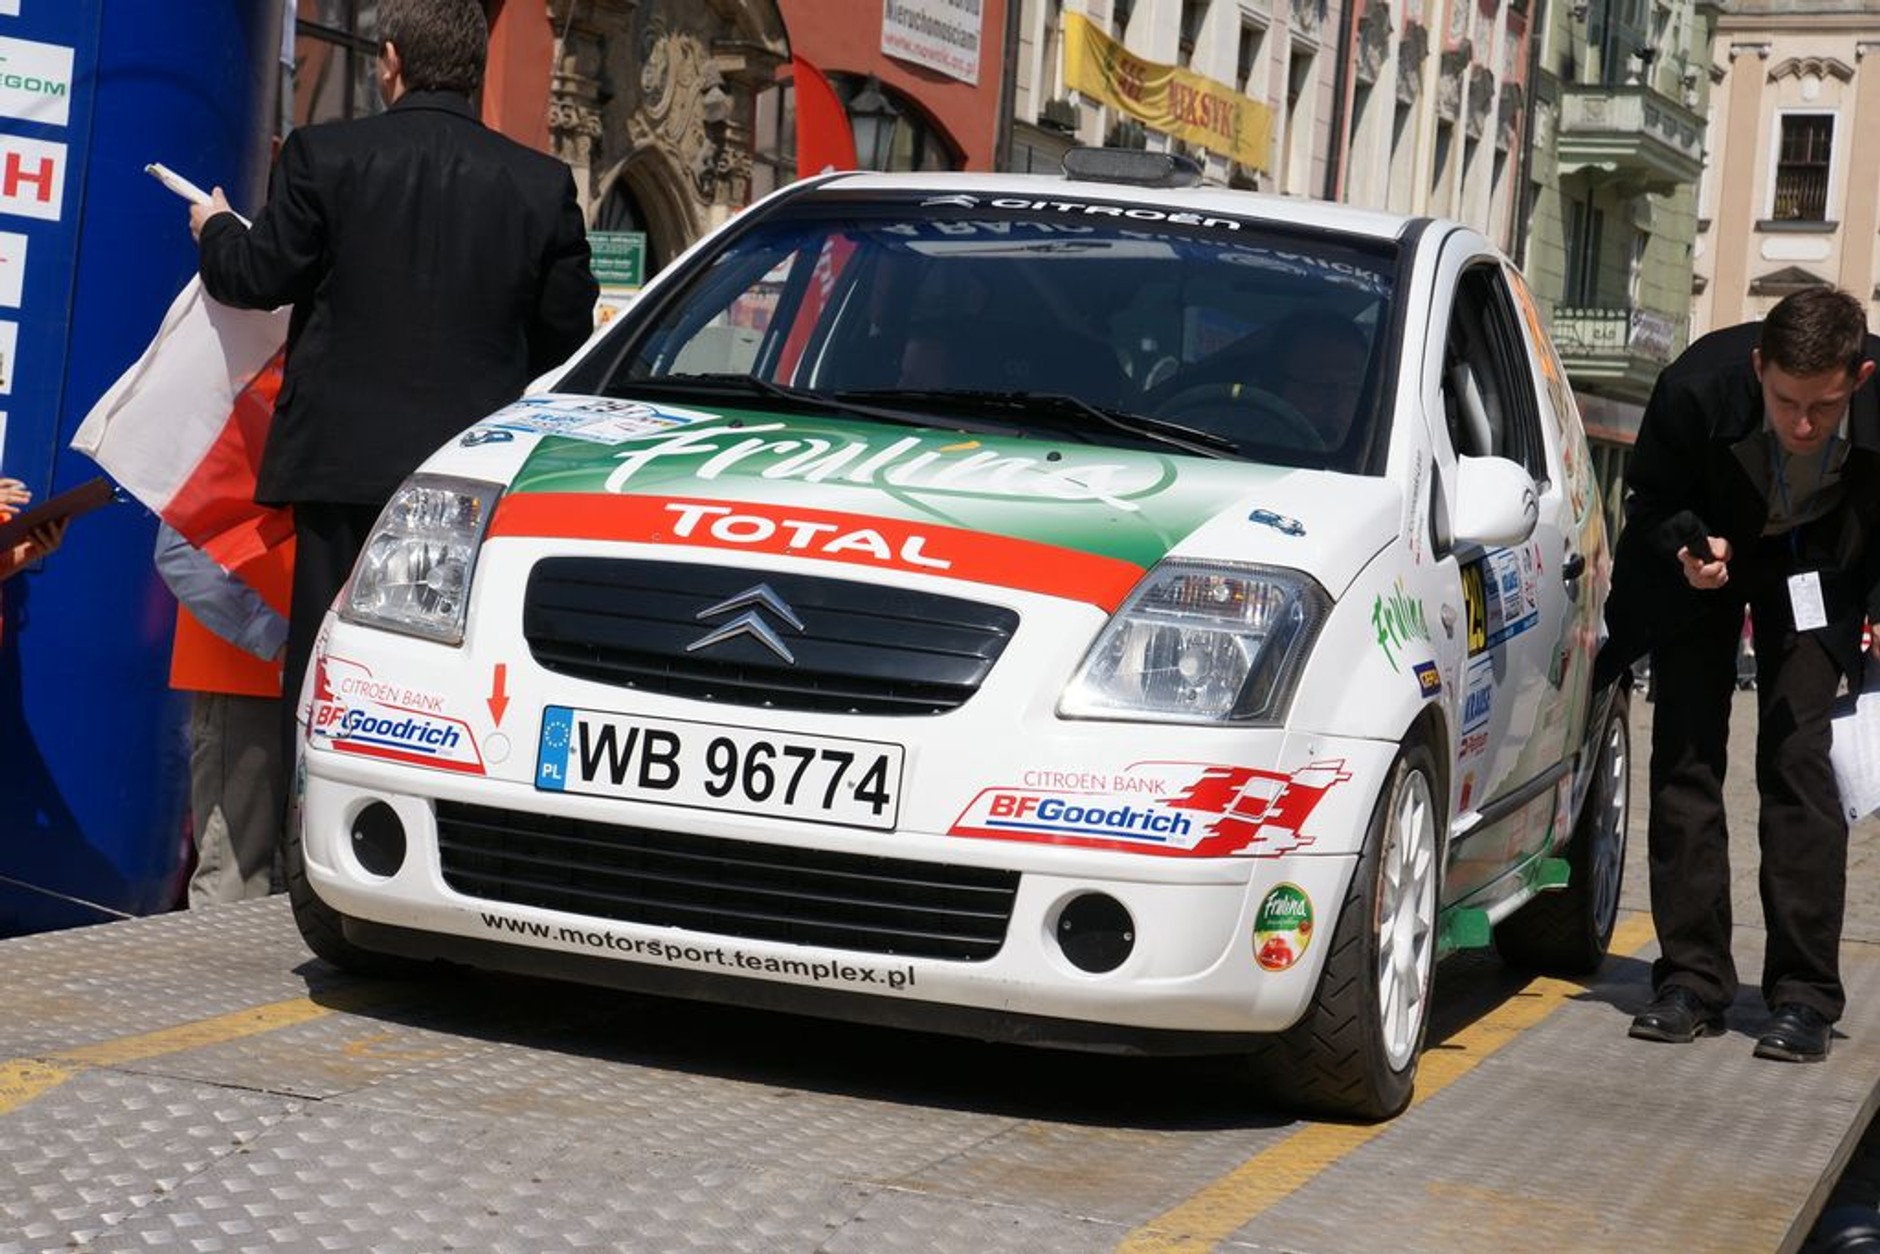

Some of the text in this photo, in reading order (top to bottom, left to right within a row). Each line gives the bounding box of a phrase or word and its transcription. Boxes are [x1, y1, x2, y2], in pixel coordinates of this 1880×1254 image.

[0, 74, 66, 96] GOM
[665, 503, 952, 570] TOTAL
[402, 690, 445, 713] BANK
[316, 705, 460, 748] BFGoodrich
[541, 763, 561, 781] PL
[578, 720, 890, 816] WB 96774
[1113, 775, 1167, 795] BANK
[988, 794, 1192, 836] BFGoodrich
[481, 911, 916, 987] www.motorsport.teamplex.pl
